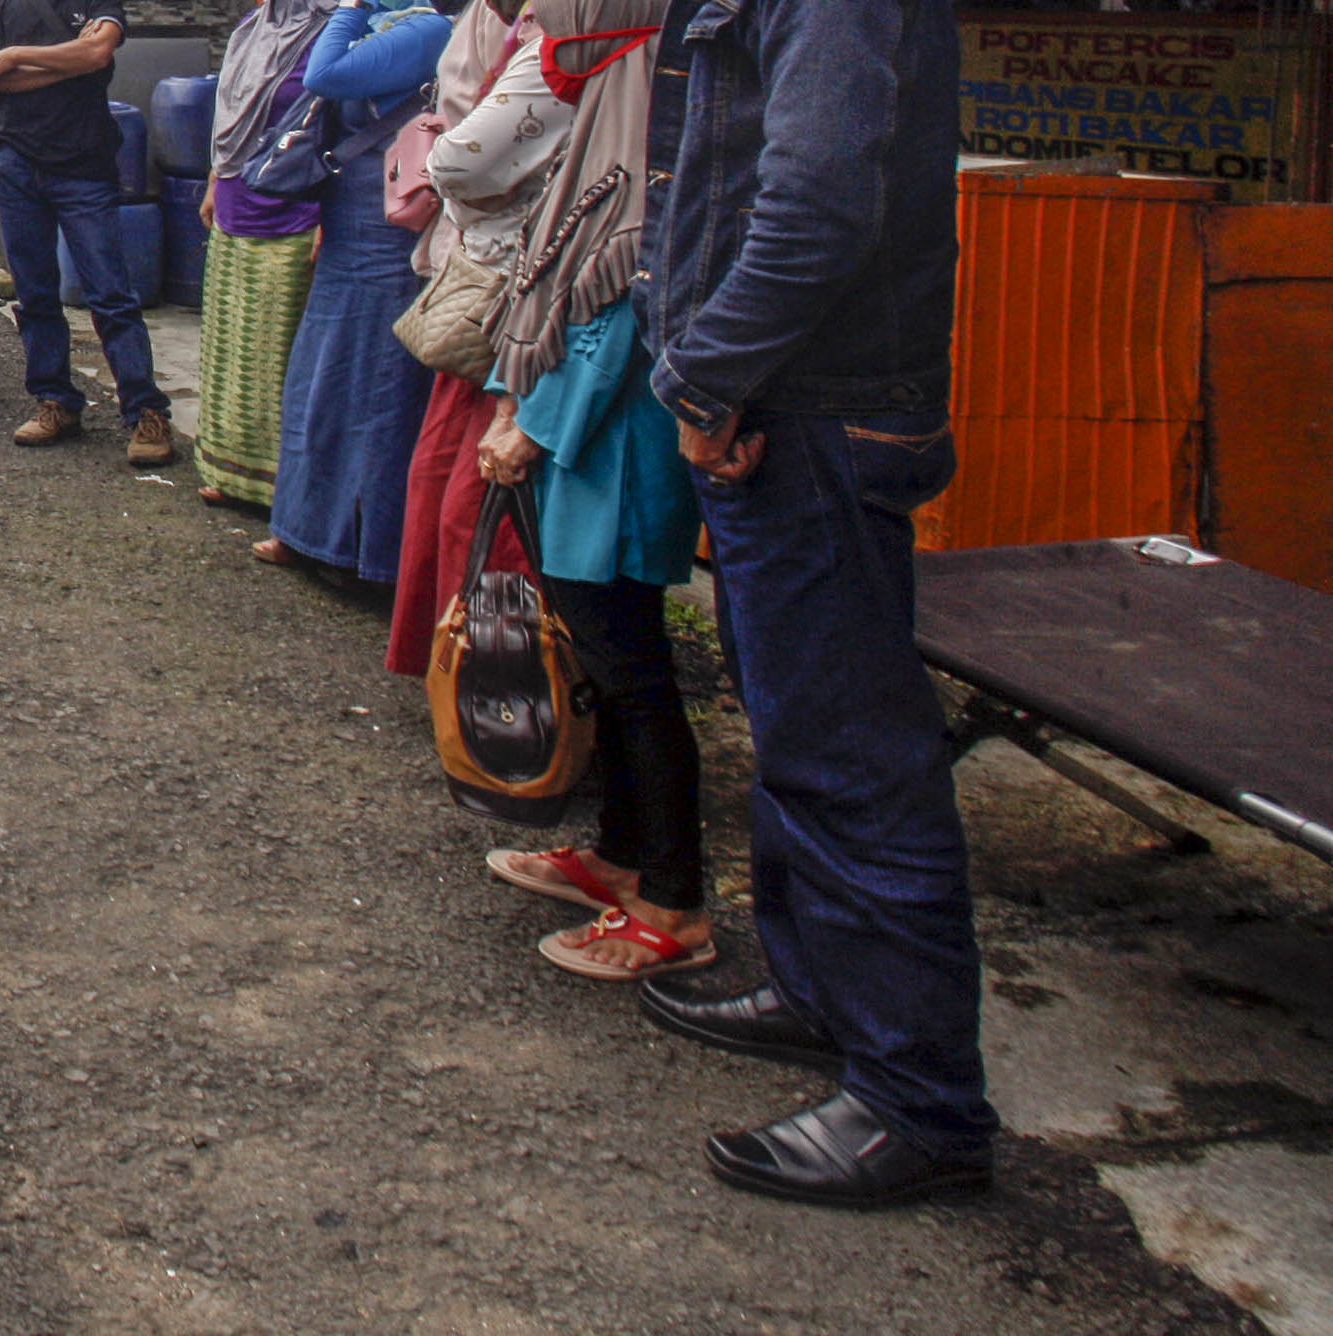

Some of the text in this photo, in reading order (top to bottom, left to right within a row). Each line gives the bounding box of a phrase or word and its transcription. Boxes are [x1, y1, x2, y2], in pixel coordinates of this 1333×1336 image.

[979, 29, 1236, 61] POFFERCIS
[1001, 55, 1215, 89] PANCAKE
[1103, 88, 1273, 123] BAKAR
[974, 106, 1246, 151] ROTI BAKAR
[1114, 144, 1288, 184] TELOR
